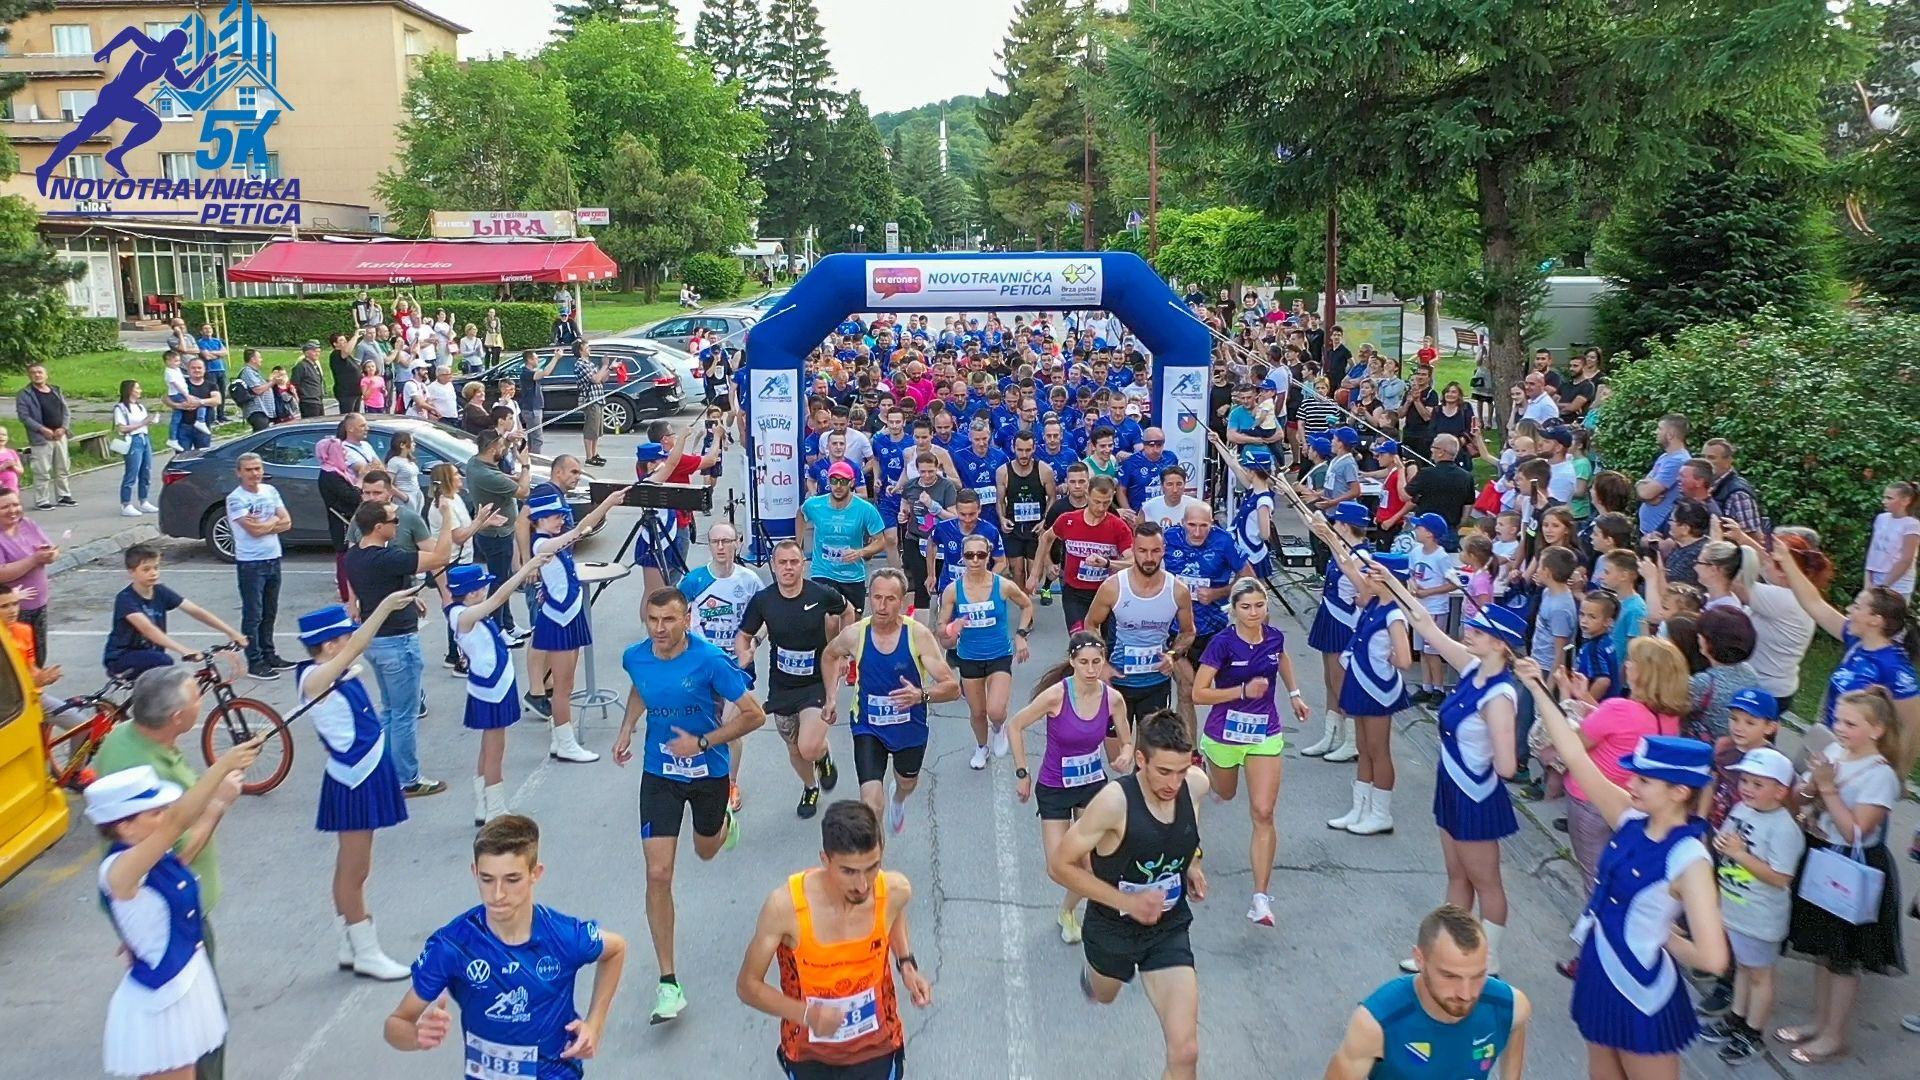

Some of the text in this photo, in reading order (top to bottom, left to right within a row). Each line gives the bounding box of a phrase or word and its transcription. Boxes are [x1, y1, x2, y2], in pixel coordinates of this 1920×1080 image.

[472, 219, 547, 236] LIRA
[389, 276, 412, 284] LIRA
[928, 269, 1053, 285] NOVOTRAVNIČKA
[1000, 284, 1052, 296] PETICA
[969, 610, 986, 621] 013
[715, 630, 734, 639] 067
[784, 657, 806, 668] 054
[1135, 655, 1153, 665] 187
[1236, 722, 1257, 734] 017
[1077, 763, 1092, 776] 111
[480, 1053, 519, 1075] 088
